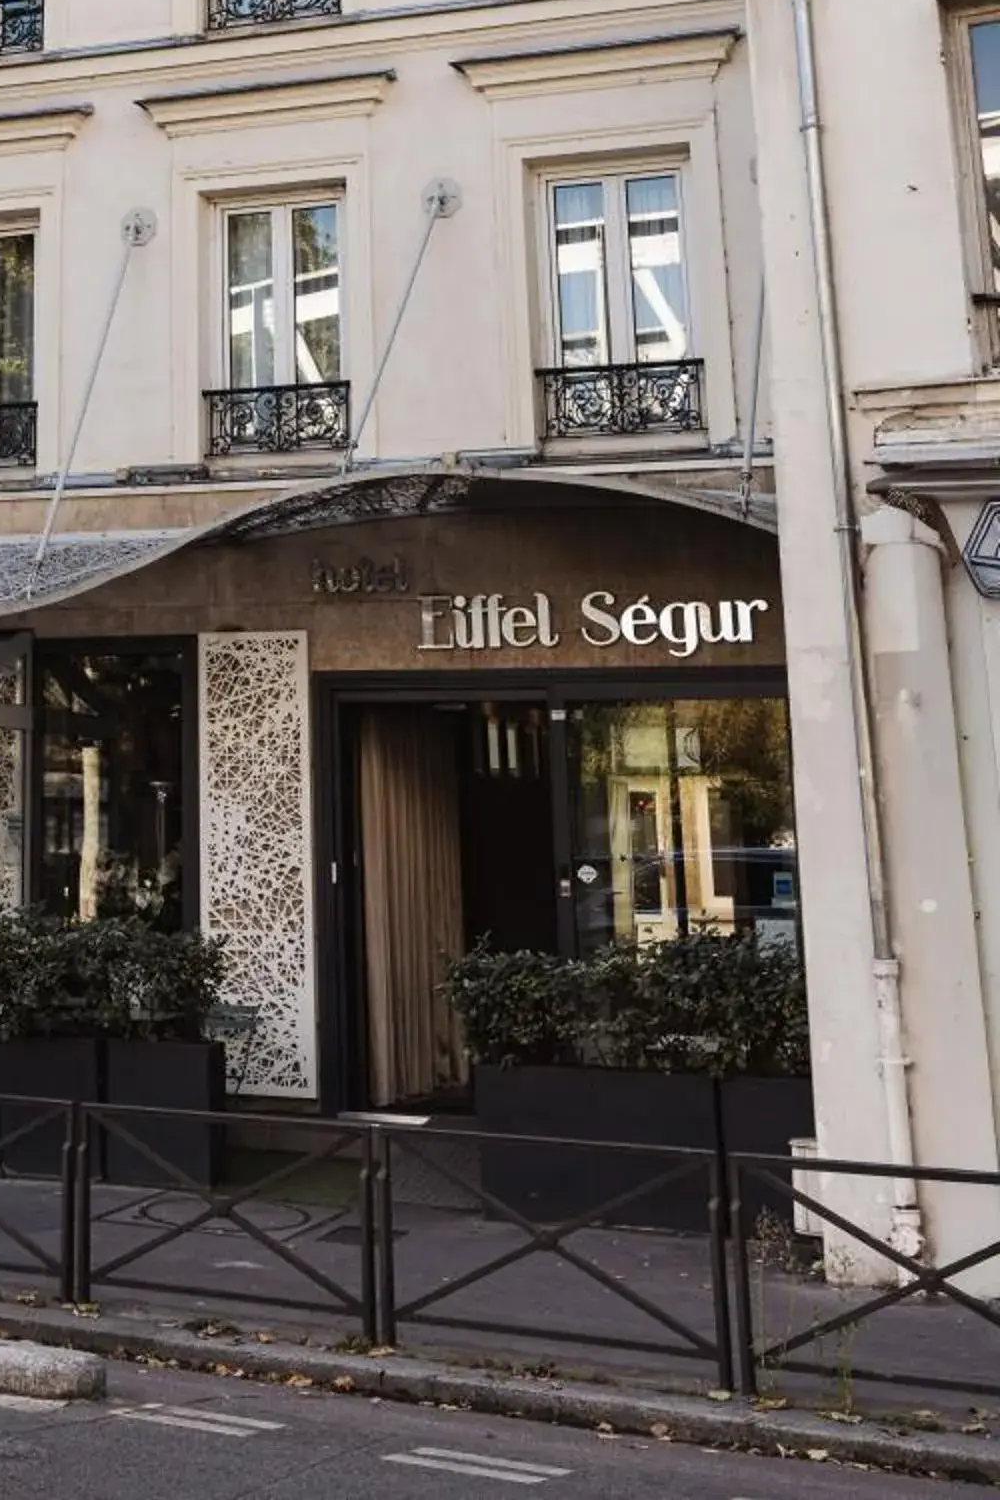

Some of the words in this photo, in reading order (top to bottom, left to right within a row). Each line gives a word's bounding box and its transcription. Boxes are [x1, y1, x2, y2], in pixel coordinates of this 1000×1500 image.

[310, 554, 408, 593] hotel
[417, 590, 559, 649] Eiffel
[581, 591, 768, 657] Ségur
